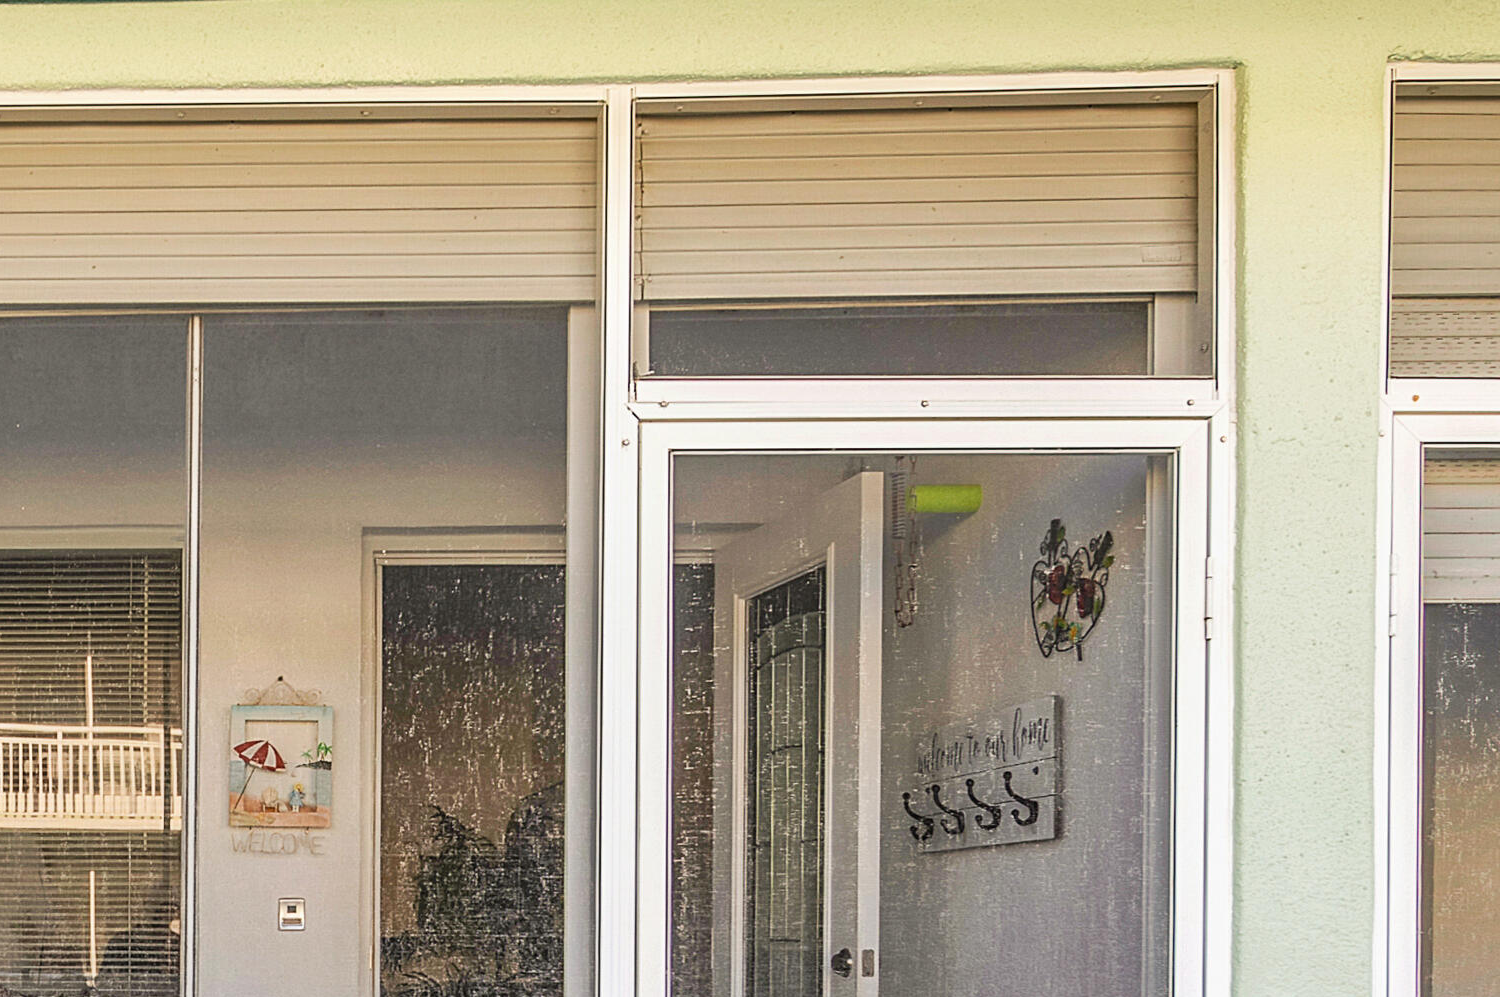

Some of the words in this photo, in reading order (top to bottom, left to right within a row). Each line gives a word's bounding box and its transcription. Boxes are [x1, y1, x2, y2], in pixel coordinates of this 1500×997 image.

[918, 731, 965, 774] welcome
[965, 732, 981, 764] to
[984, 729, 1009, 763] our
[1012, 707, 1049, 760] home
[231, 831, 325, 855] WELCOME
